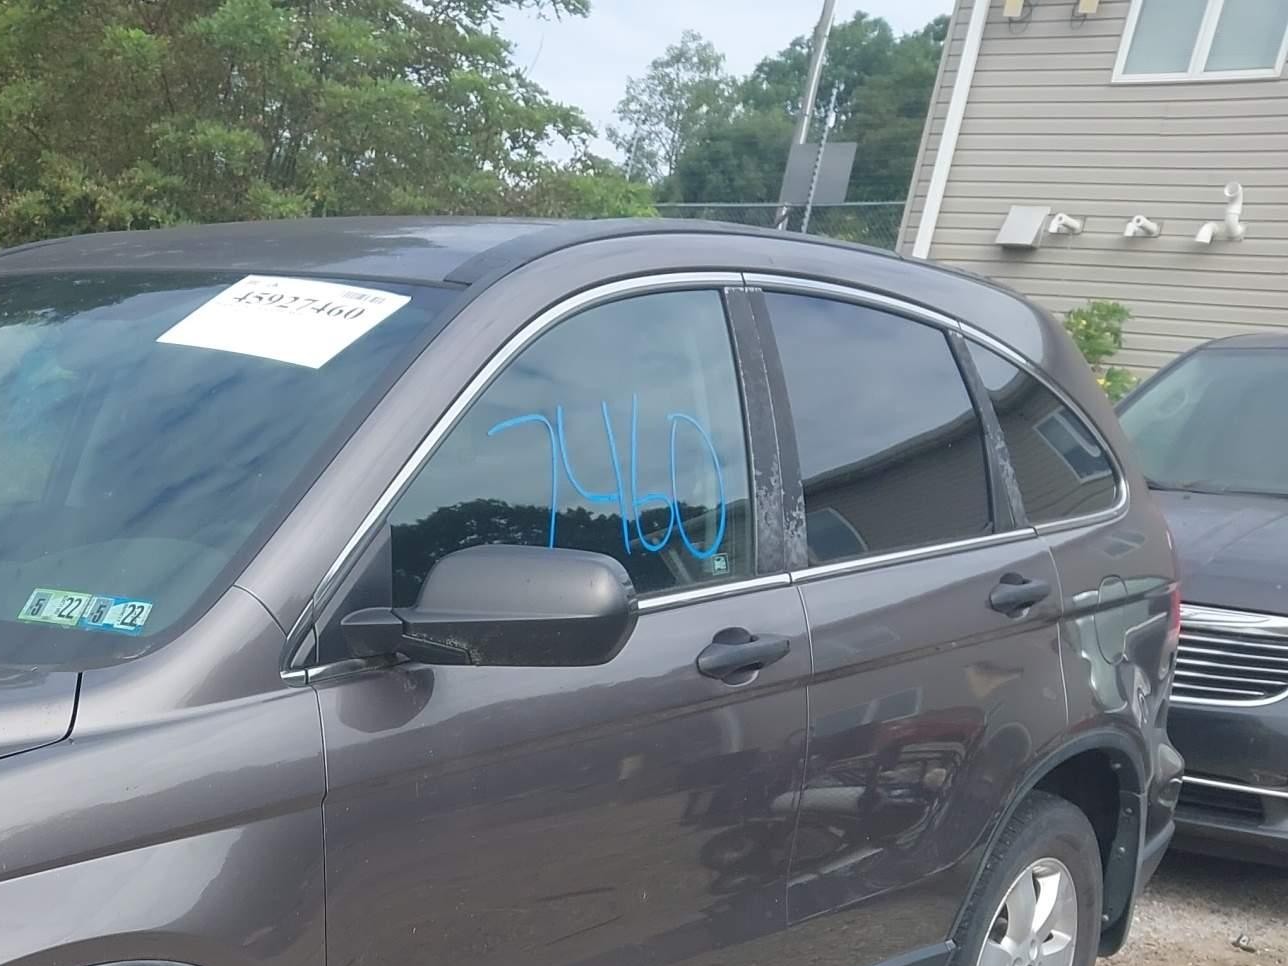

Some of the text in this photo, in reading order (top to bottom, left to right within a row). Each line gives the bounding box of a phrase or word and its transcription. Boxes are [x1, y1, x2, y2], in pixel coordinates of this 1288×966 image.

[233, 291, 366, 321] 45927460
[487, 392, 728, 560] 7460
[31, 597, 82, 619] 5 22
[93, 604, 144, 626] 5 22
